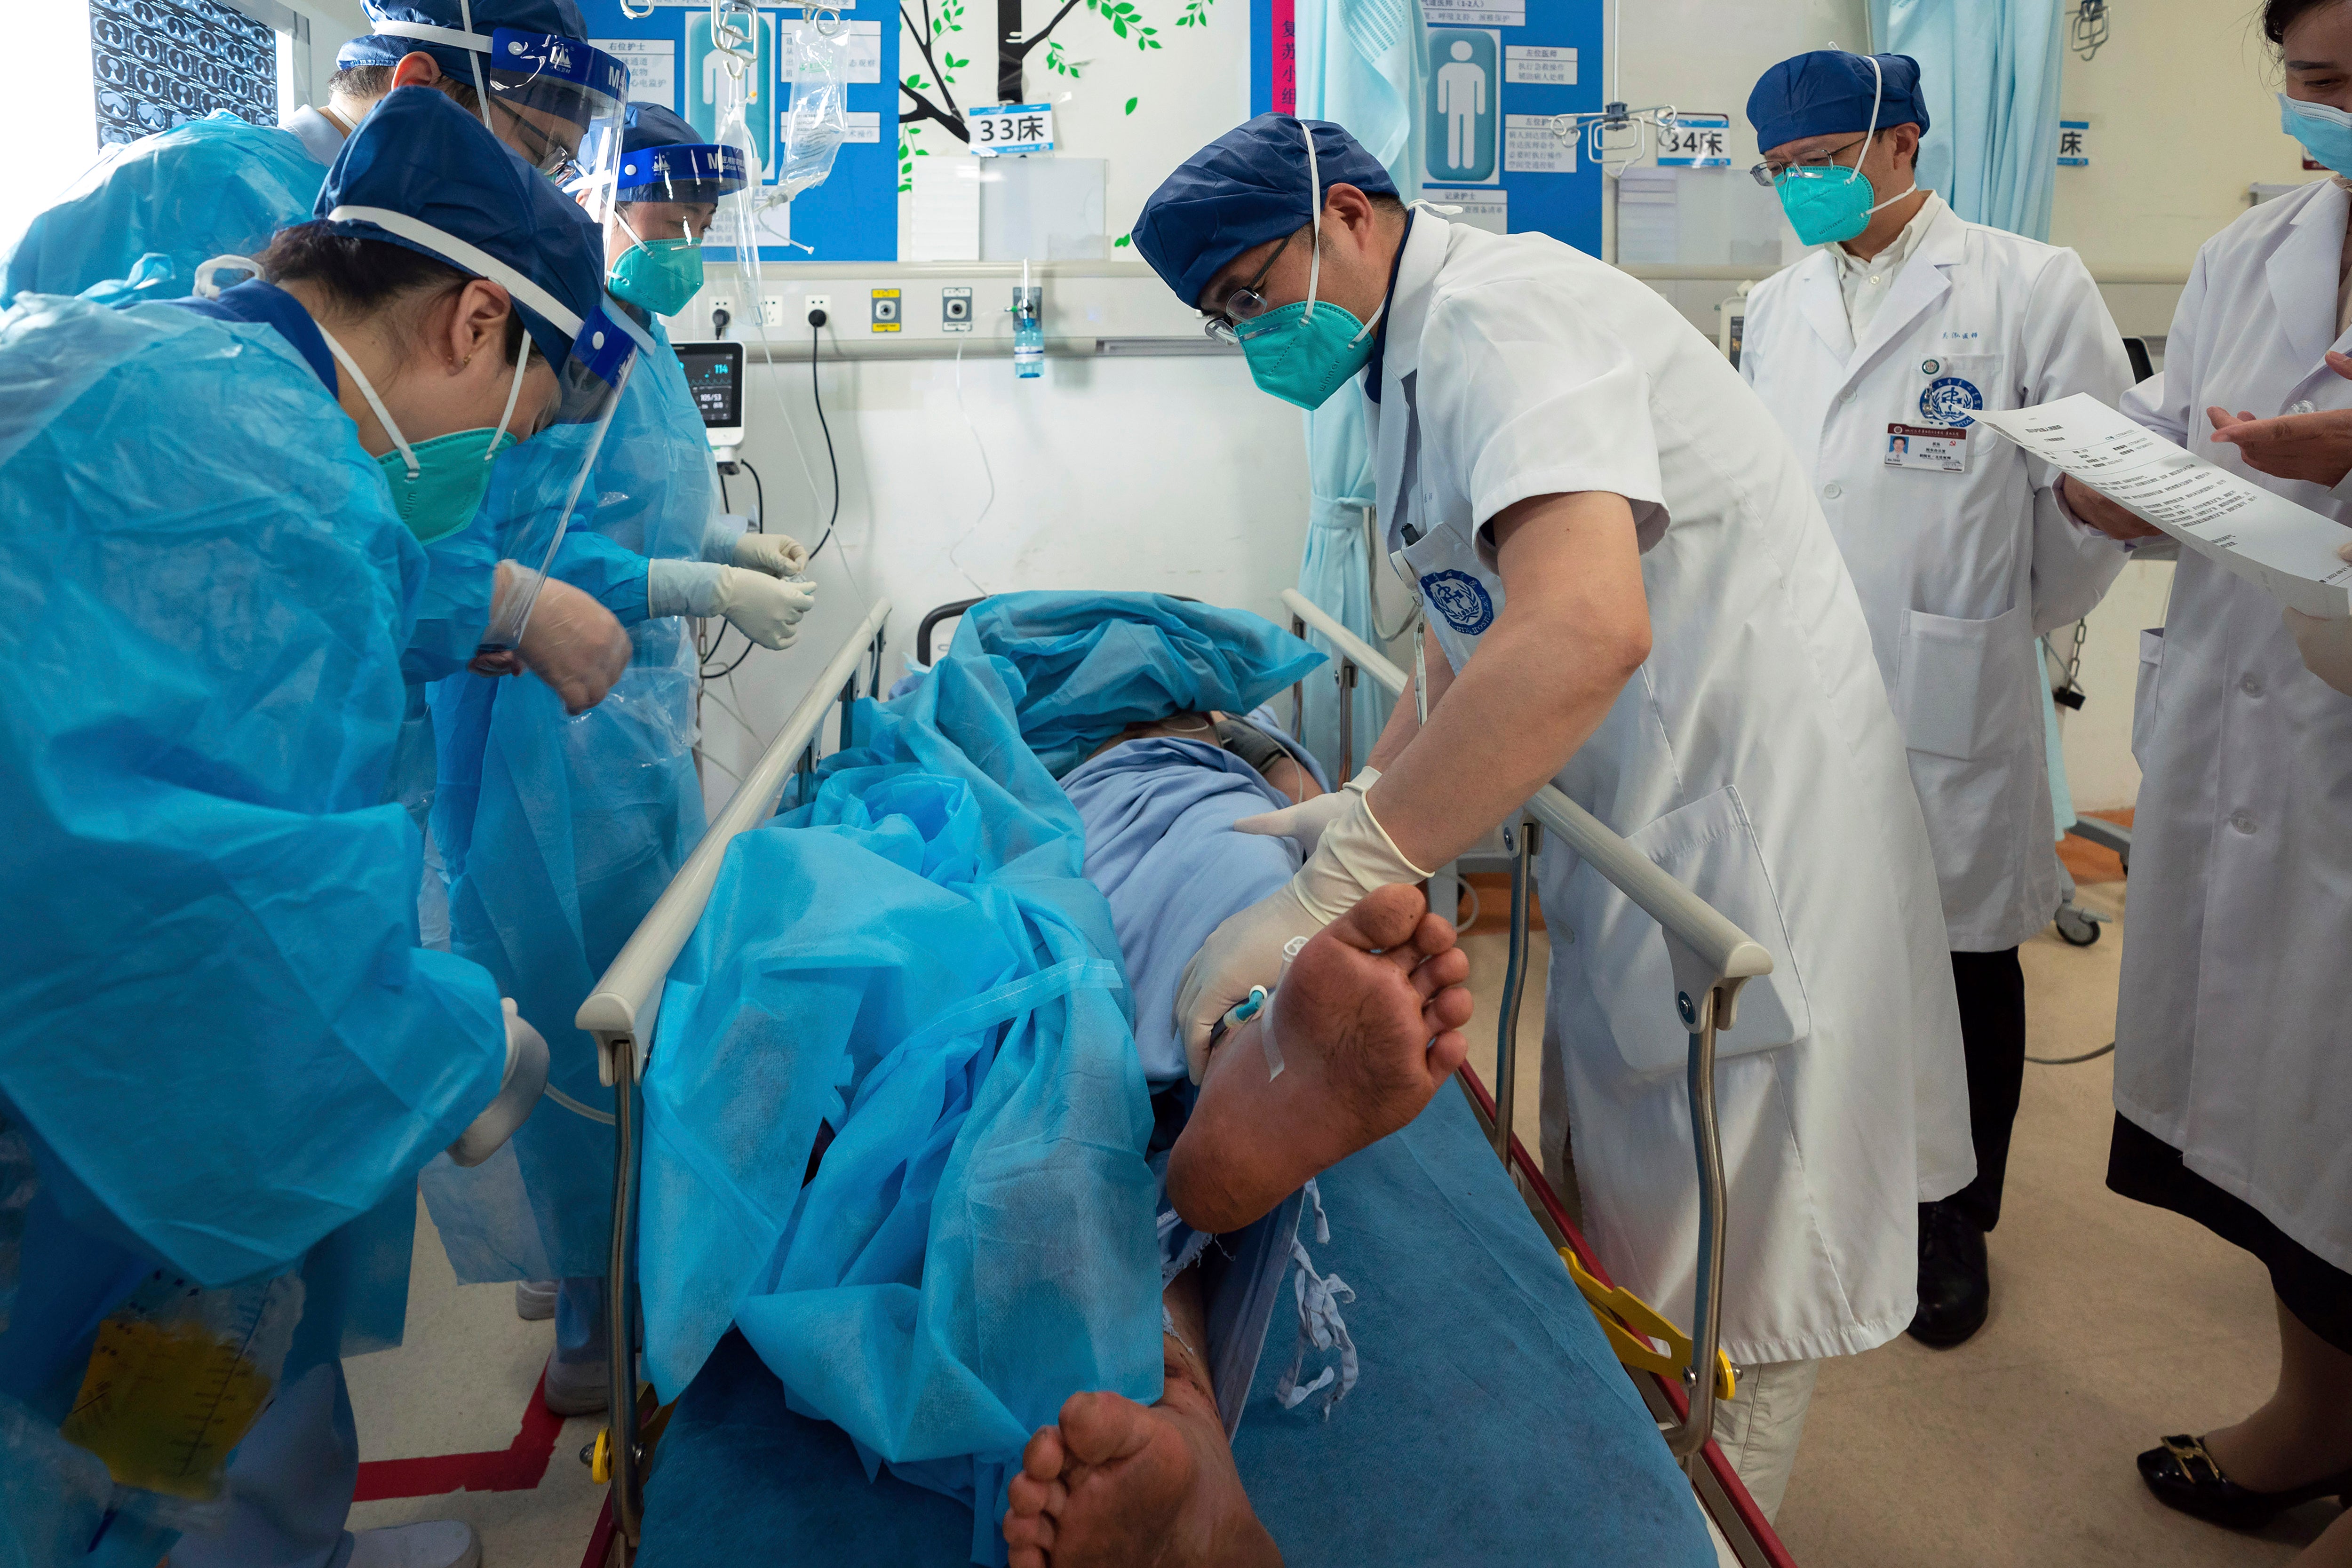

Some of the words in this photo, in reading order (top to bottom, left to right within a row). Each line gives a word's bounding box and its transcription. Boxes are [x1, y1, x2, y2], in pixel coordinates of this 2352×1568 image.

[609, 42, 645, 51] 右位护士
[1281, 20, 1296, 118] 复苏小组
[981, 115, 1044, 142] 33床
[1526, 118, 1553, 126] 左位护
[1668, 130, 1723, 156] 34床
[2060, 131, 2082, 156] 床
[715, 364, 728, 374] 114
[1319, 359, 1340, 392] winner
